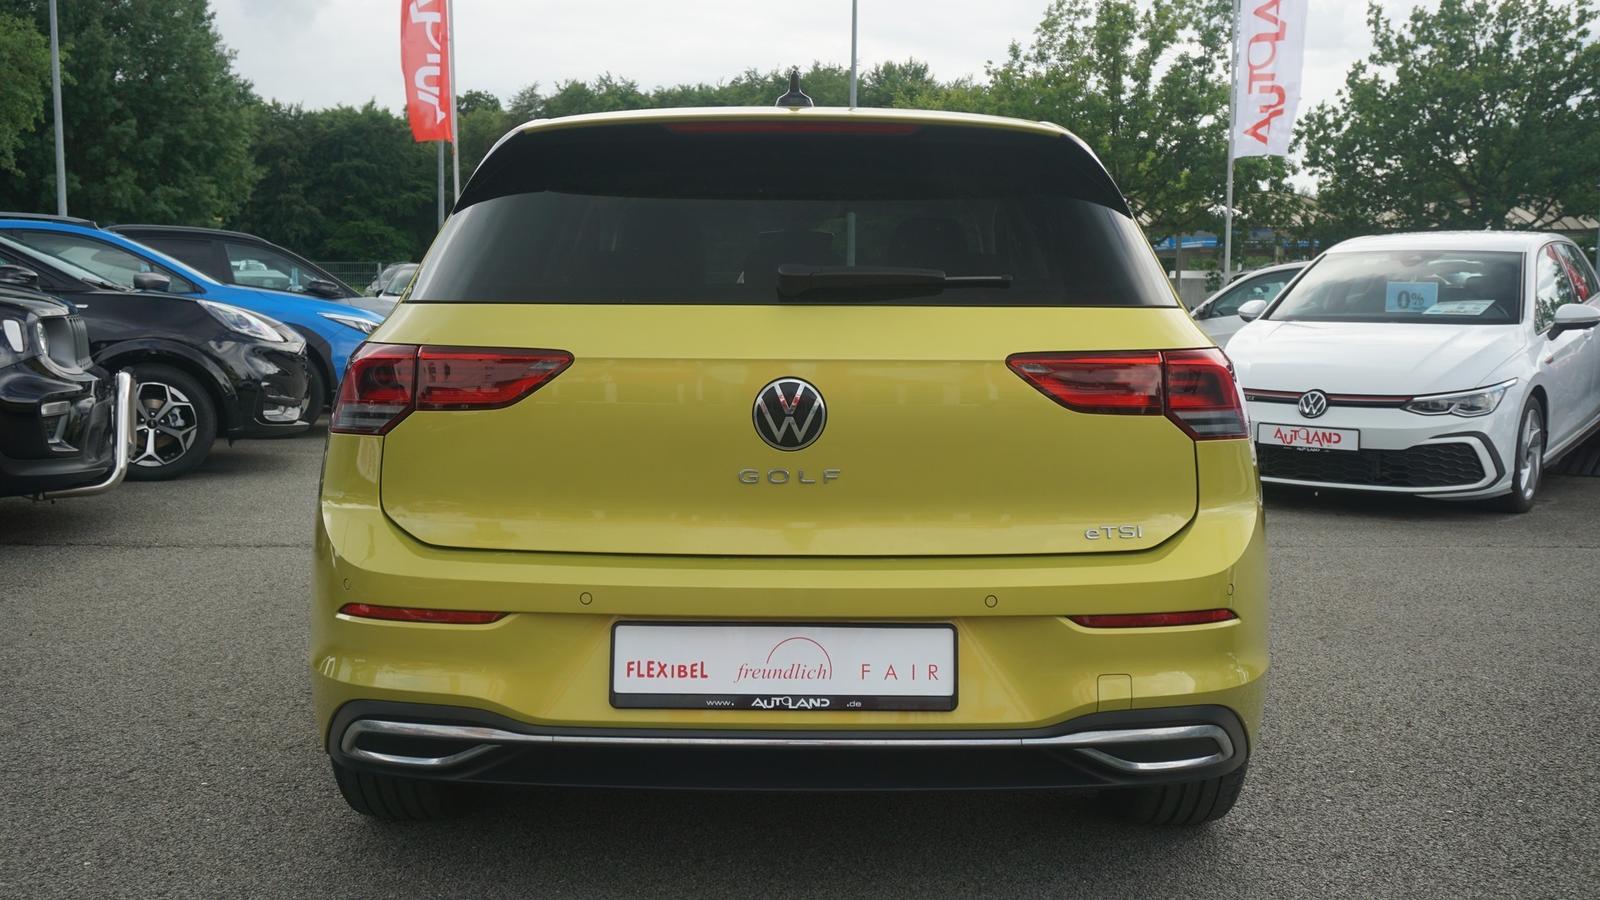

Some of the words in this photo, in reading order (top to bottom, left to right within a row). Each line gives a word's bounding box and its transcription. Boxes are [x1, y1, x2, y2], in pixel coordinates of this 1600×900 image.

[1274, 427, 1342, 447] AUTOLAND
[738, 468, 841, 484] GOLF
[1084, 525, 1143, 540] eTSI
[626, 660, 709, 679] FLEXIBEL
[733, 663, 828, 683] freundlich
[861, 663, 939, 680] FAIR
[751, 696, 830, 709] AUTOLAND
